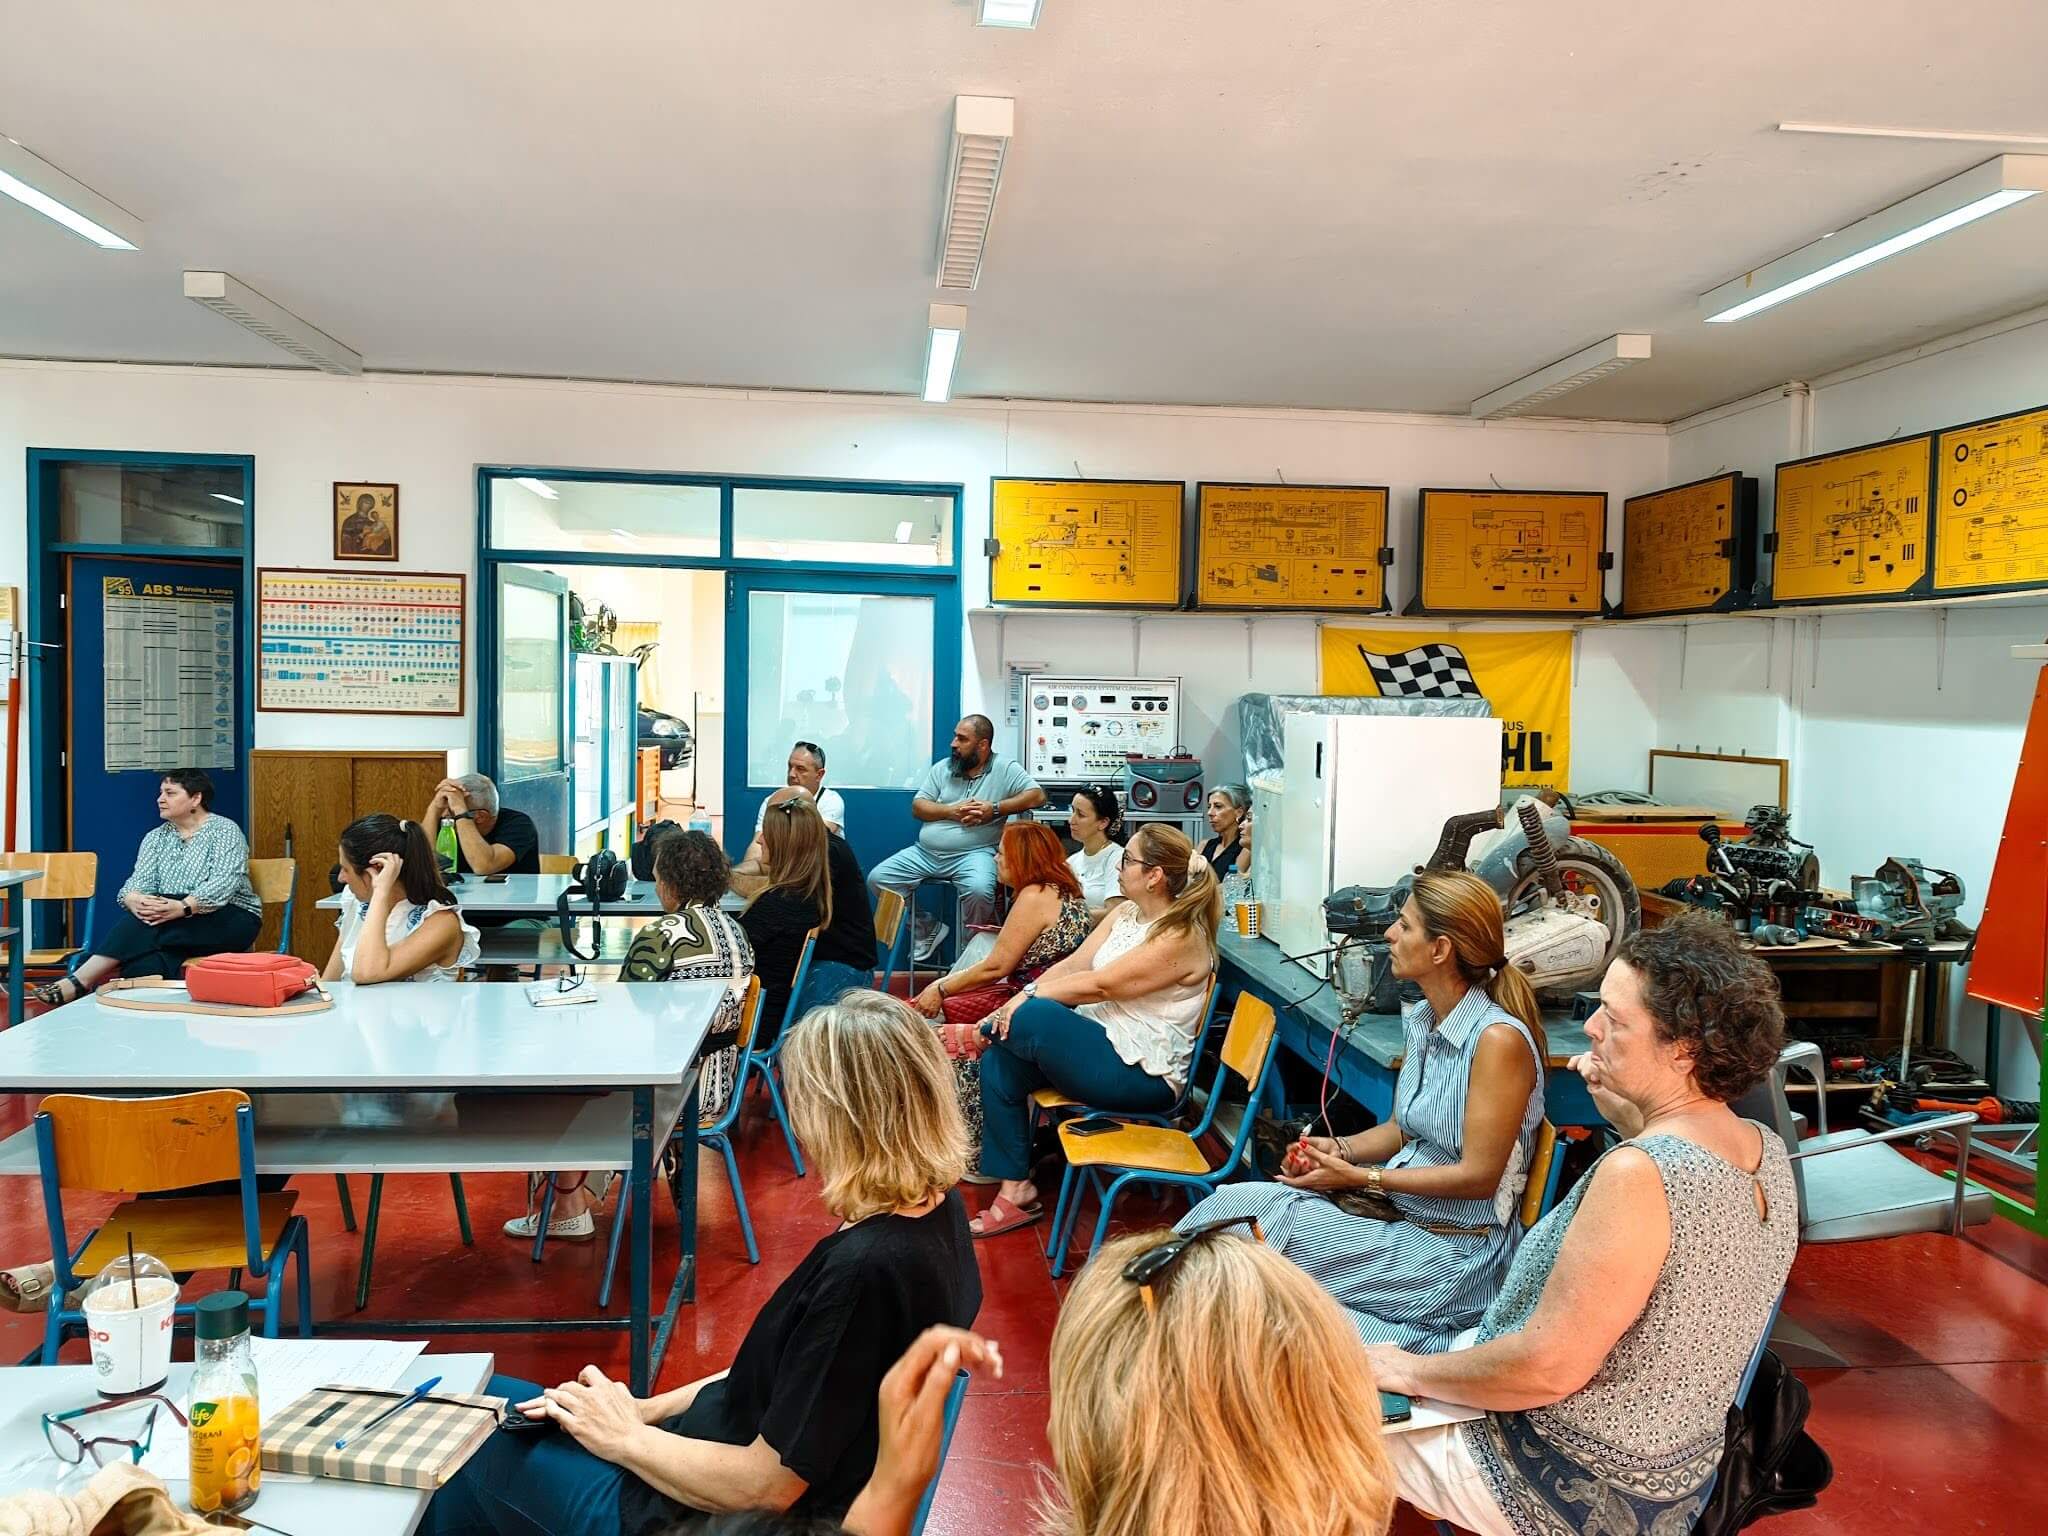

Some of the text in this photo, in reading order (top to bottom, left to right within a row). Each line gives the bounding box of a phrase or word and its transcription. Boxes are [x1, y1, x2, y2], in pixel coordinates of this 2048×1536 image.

[118, 585, 131, 595] 95
[143, 583, 173, 595] ABS
[176, 586, 207, 594] Warning
